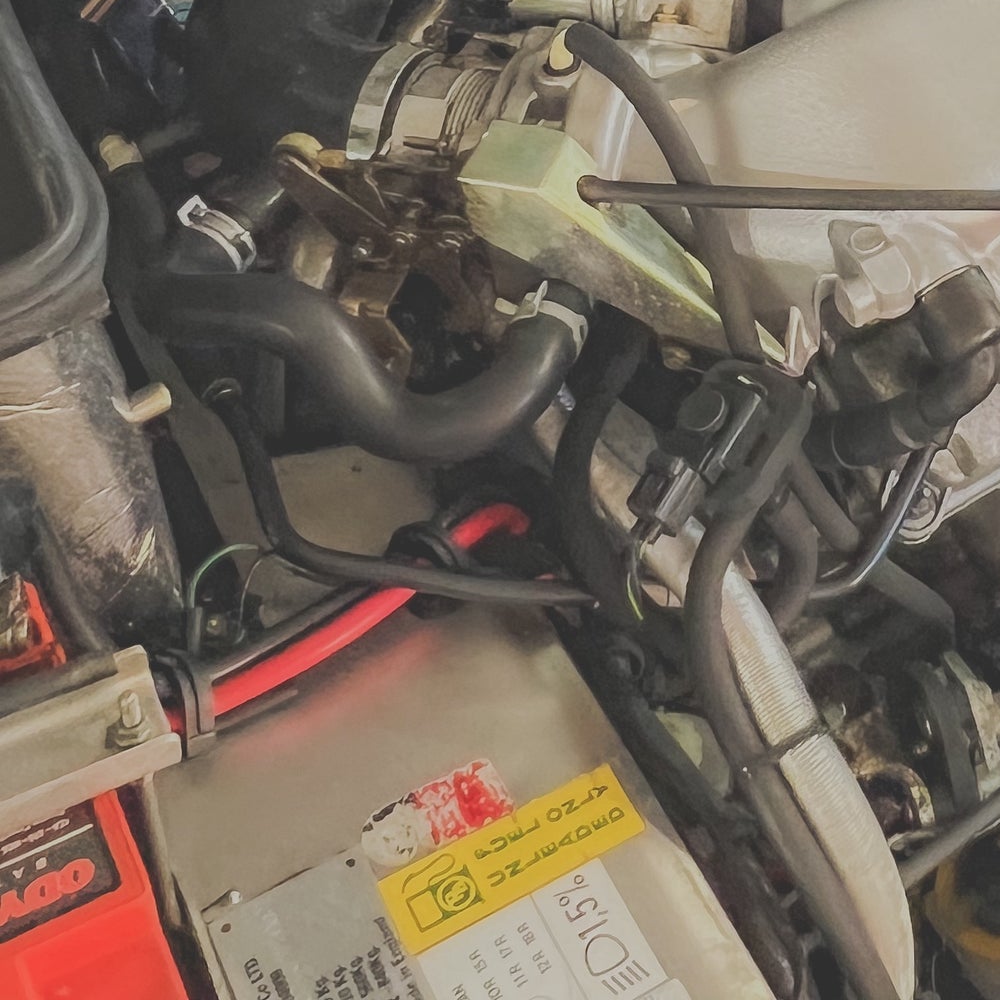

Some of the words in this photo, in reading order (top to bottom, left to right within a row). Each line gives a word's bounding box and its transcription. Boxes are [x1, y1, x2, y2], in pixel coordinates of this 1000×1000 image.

[473, 817, 541, 860] FUEL
[545, 784, 609, 824] ONLY
[486, 806, 625, 889] UNLEADED
